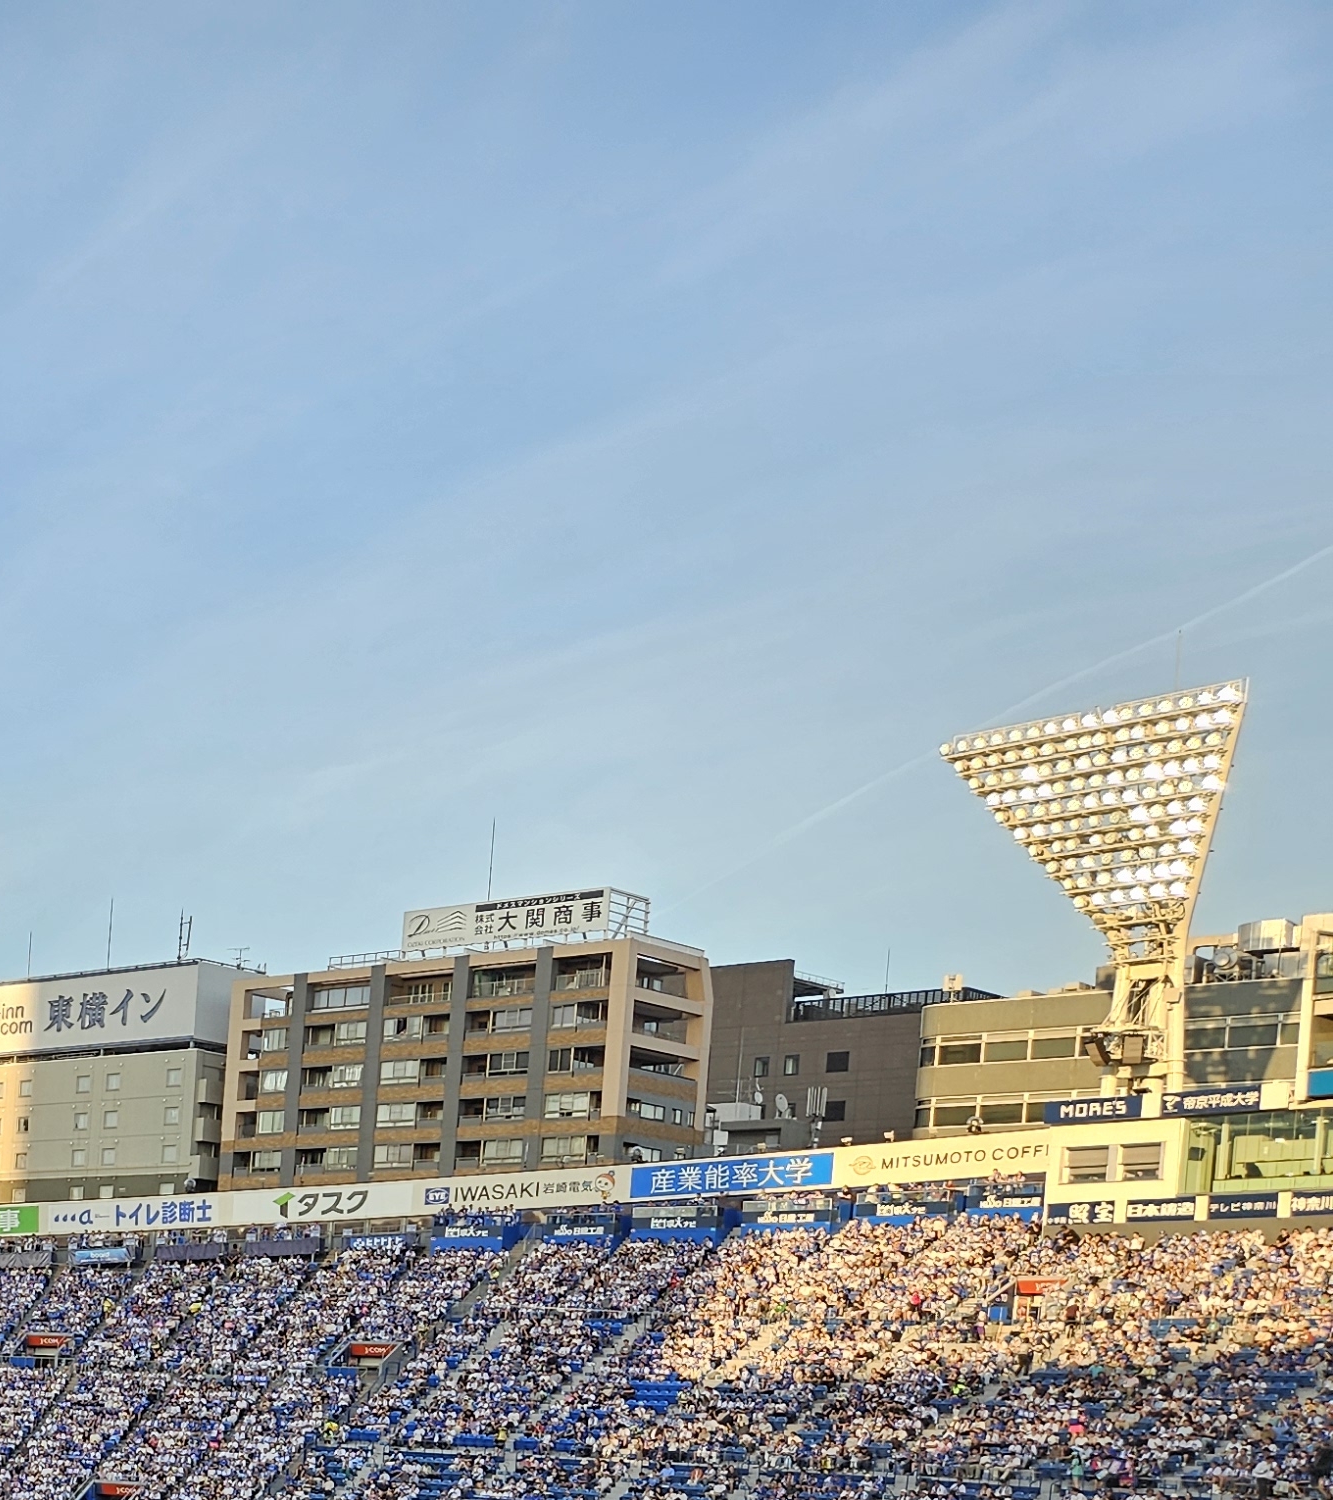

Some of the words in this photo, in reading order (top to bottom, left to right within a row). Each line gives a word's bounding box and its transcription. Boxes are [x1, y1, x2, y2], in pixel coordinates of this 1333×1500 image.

[475, 913, 494, 923] 株式
[497, 901, 602, 932] 大関商事
[475, 925, 493, 935] 会社
[44, 988, 166, 1032] 東横イン
[1183, 1091, 1259, 1111] 帝京平成大学
[881, 1150, 986, 1169] MITSUMOTO
[543, 1178, 592, 1194] 岩崎電気
[650, 1158, 814, 1195] 産業能率大学
[297, 1189, 368, 1214] タスク
[454, 1181, 540, 1202] IWASAKI
[114, 1199, 211, 1225] トイレ診断士
[1210, 1201, 1276, 1212] テレビ神奈川
